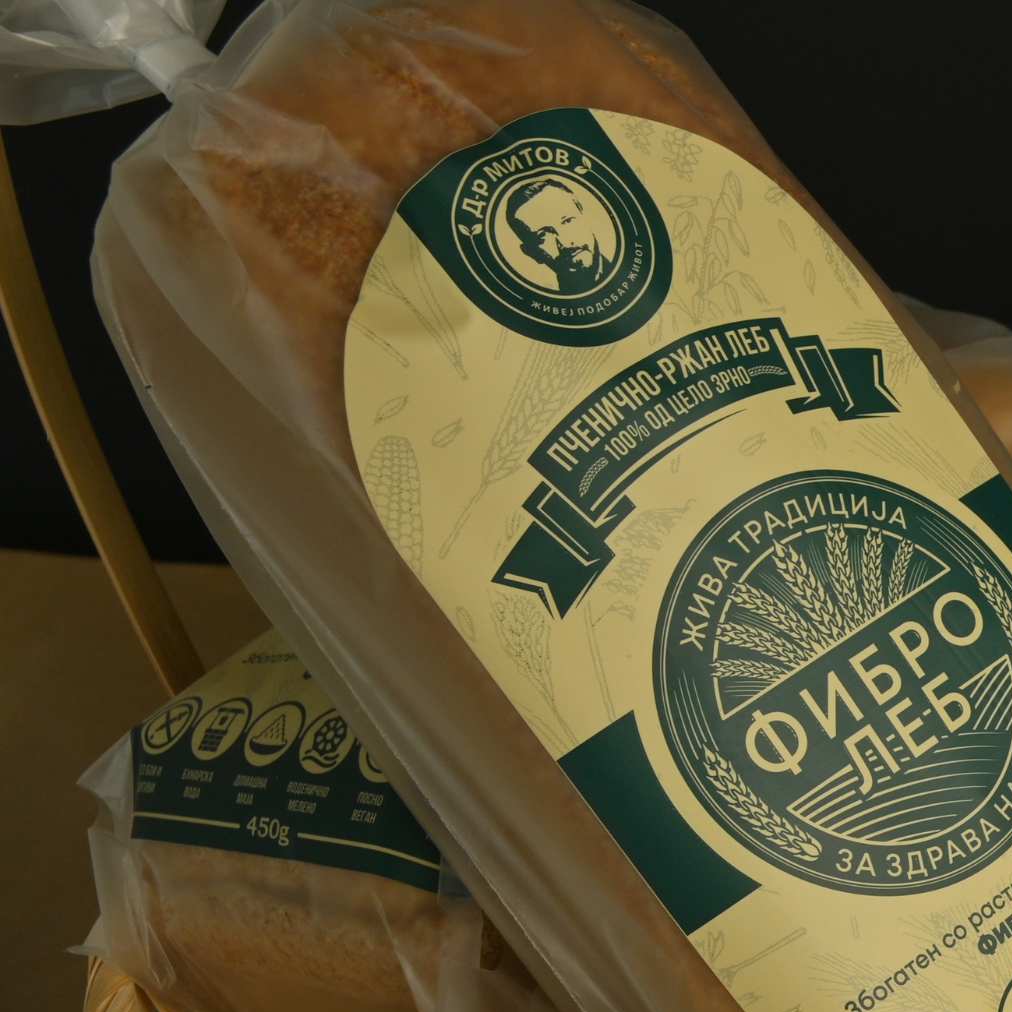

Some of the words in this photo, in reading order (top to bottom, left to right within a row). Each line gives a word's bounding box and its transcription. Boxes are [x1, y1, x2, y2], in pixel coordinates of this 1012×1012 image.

[483, 146, 570, 183] МИТОВ
[530, 300, 574, 317] ЖИВЕЈ
[577, 281, 630, 316] ПОДОБАР
[628, 242, 644, 282] ЖИВОТ
[546, 334, 729, 472] ПЧЕНИЧНО-РЖАН
[724, 325, 771, 359] ЛЕБ
[604, 420, 650, 461] 100%
[644, 406, 676, 431] ОД
[667, 380, 713, 415] ЦЕЛО
[711, 365, 751, 394] ЗРНО
[680, 555, 740, 651] ЖИВА
[727, 492, 909, 554] ТРАДИЦИЈА
[745, 591, 984, 776] ФИБРО
[842, 671, 973, 796] ЛЕБ
[246, 815, 290, 847] 450g
[835, 847, 878, 876] ЗА
[886, 817, 1001, 880] ЗДРАВА
[942, 924, 968, 949] со
